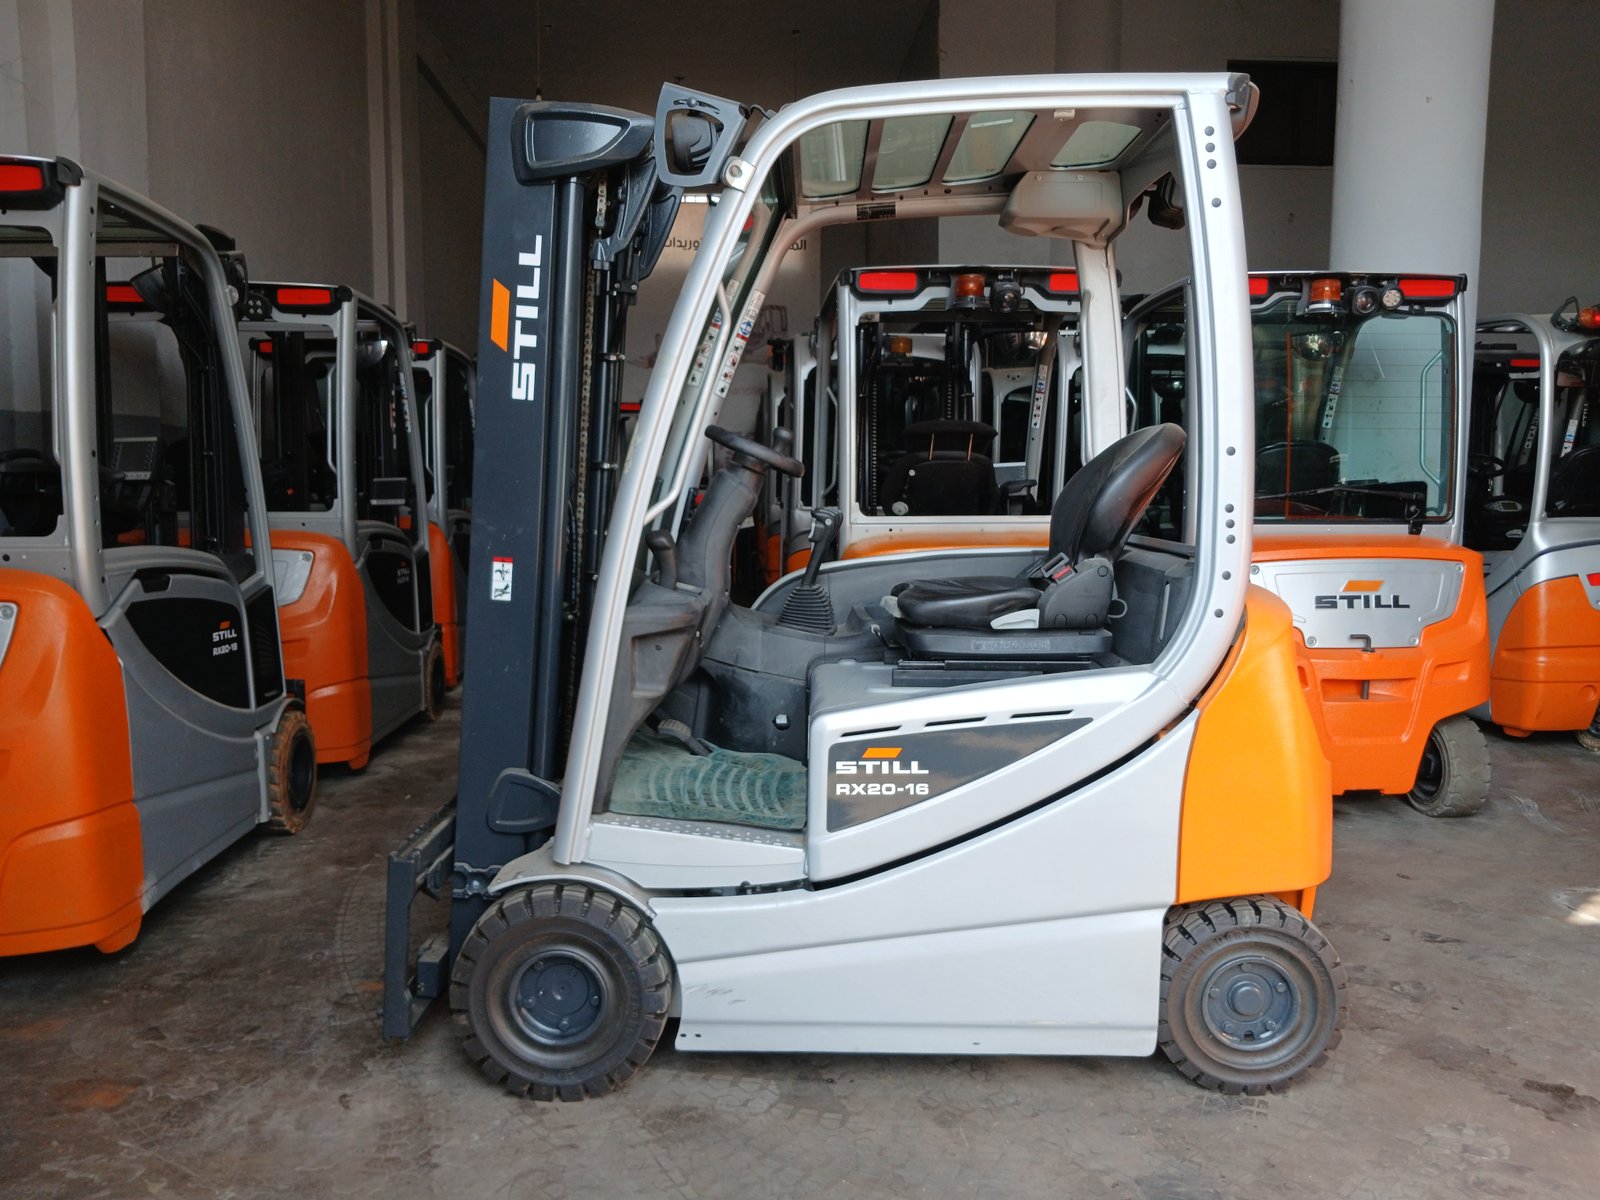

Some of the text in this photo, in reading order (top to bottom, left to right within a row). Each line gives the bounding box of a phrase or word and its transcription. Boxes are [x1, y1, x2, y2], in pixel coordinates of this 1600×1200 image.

[512, 235, 542, 401] STILL
[1315, 595, 1410, 609] STILL
[212, 629, 237, 642] STILL
[836, 761, 930, 774] STILL
[836, 783, 930, 795] RX20-16
